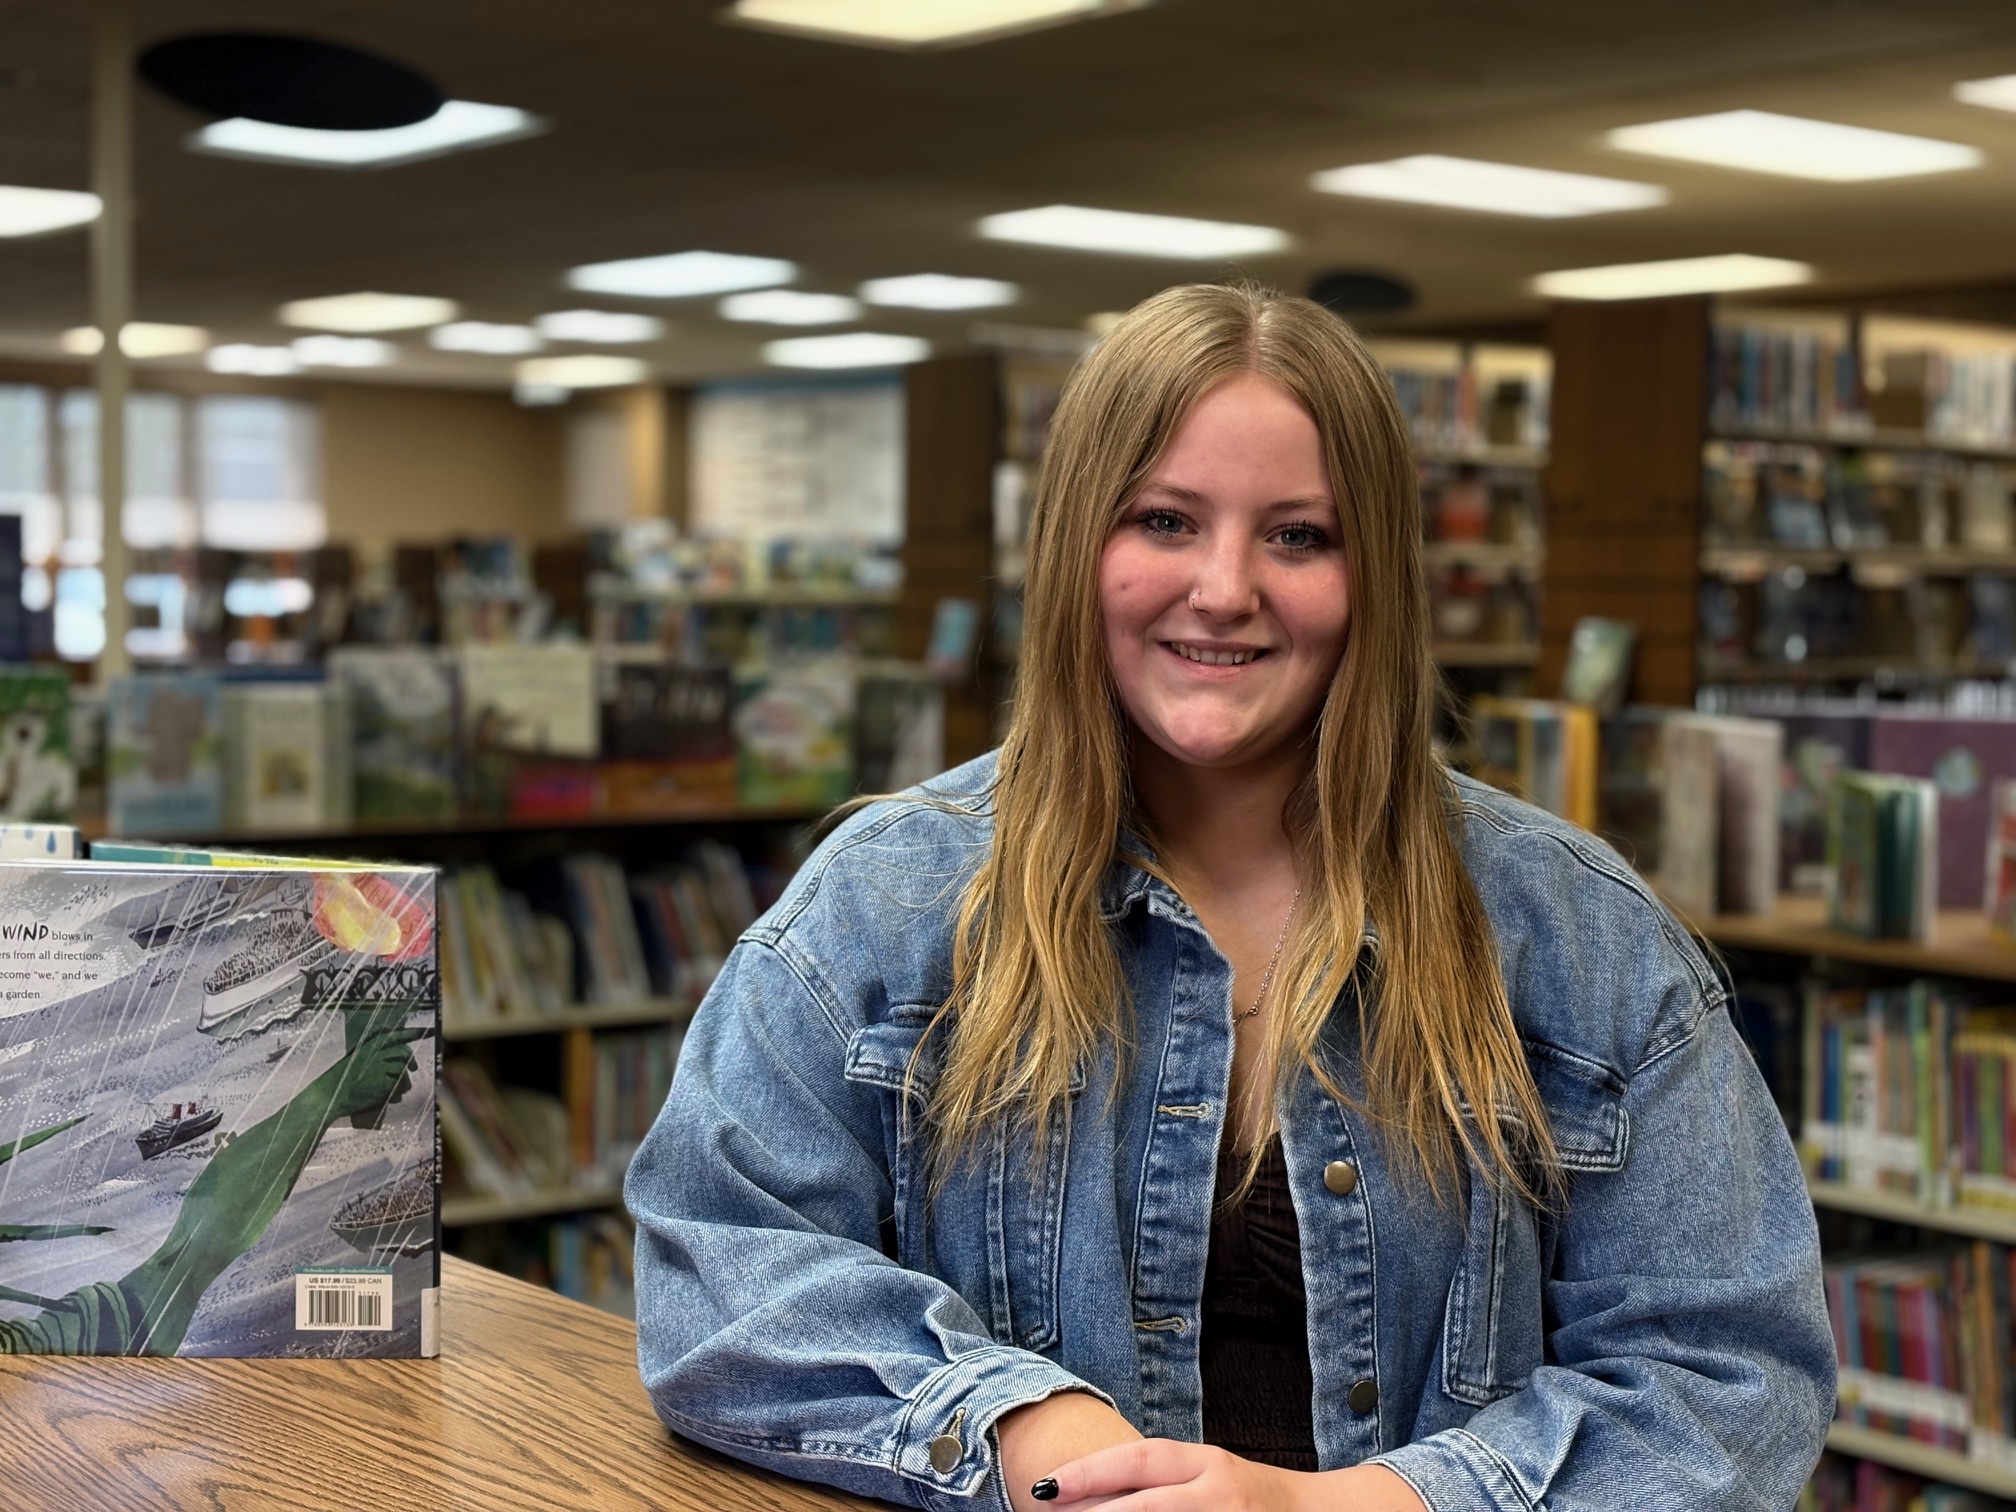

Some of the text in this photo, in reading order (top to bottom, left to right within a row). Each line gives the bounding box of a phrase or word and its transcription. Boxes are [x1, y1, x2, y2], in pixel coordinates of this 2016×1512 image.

[3, 921, 93, 942] WIND blows in
[0, 949, 106, 961] rs from all directions.
[61, 970, 81, 980] and
[83, 972, 98, 980] we
